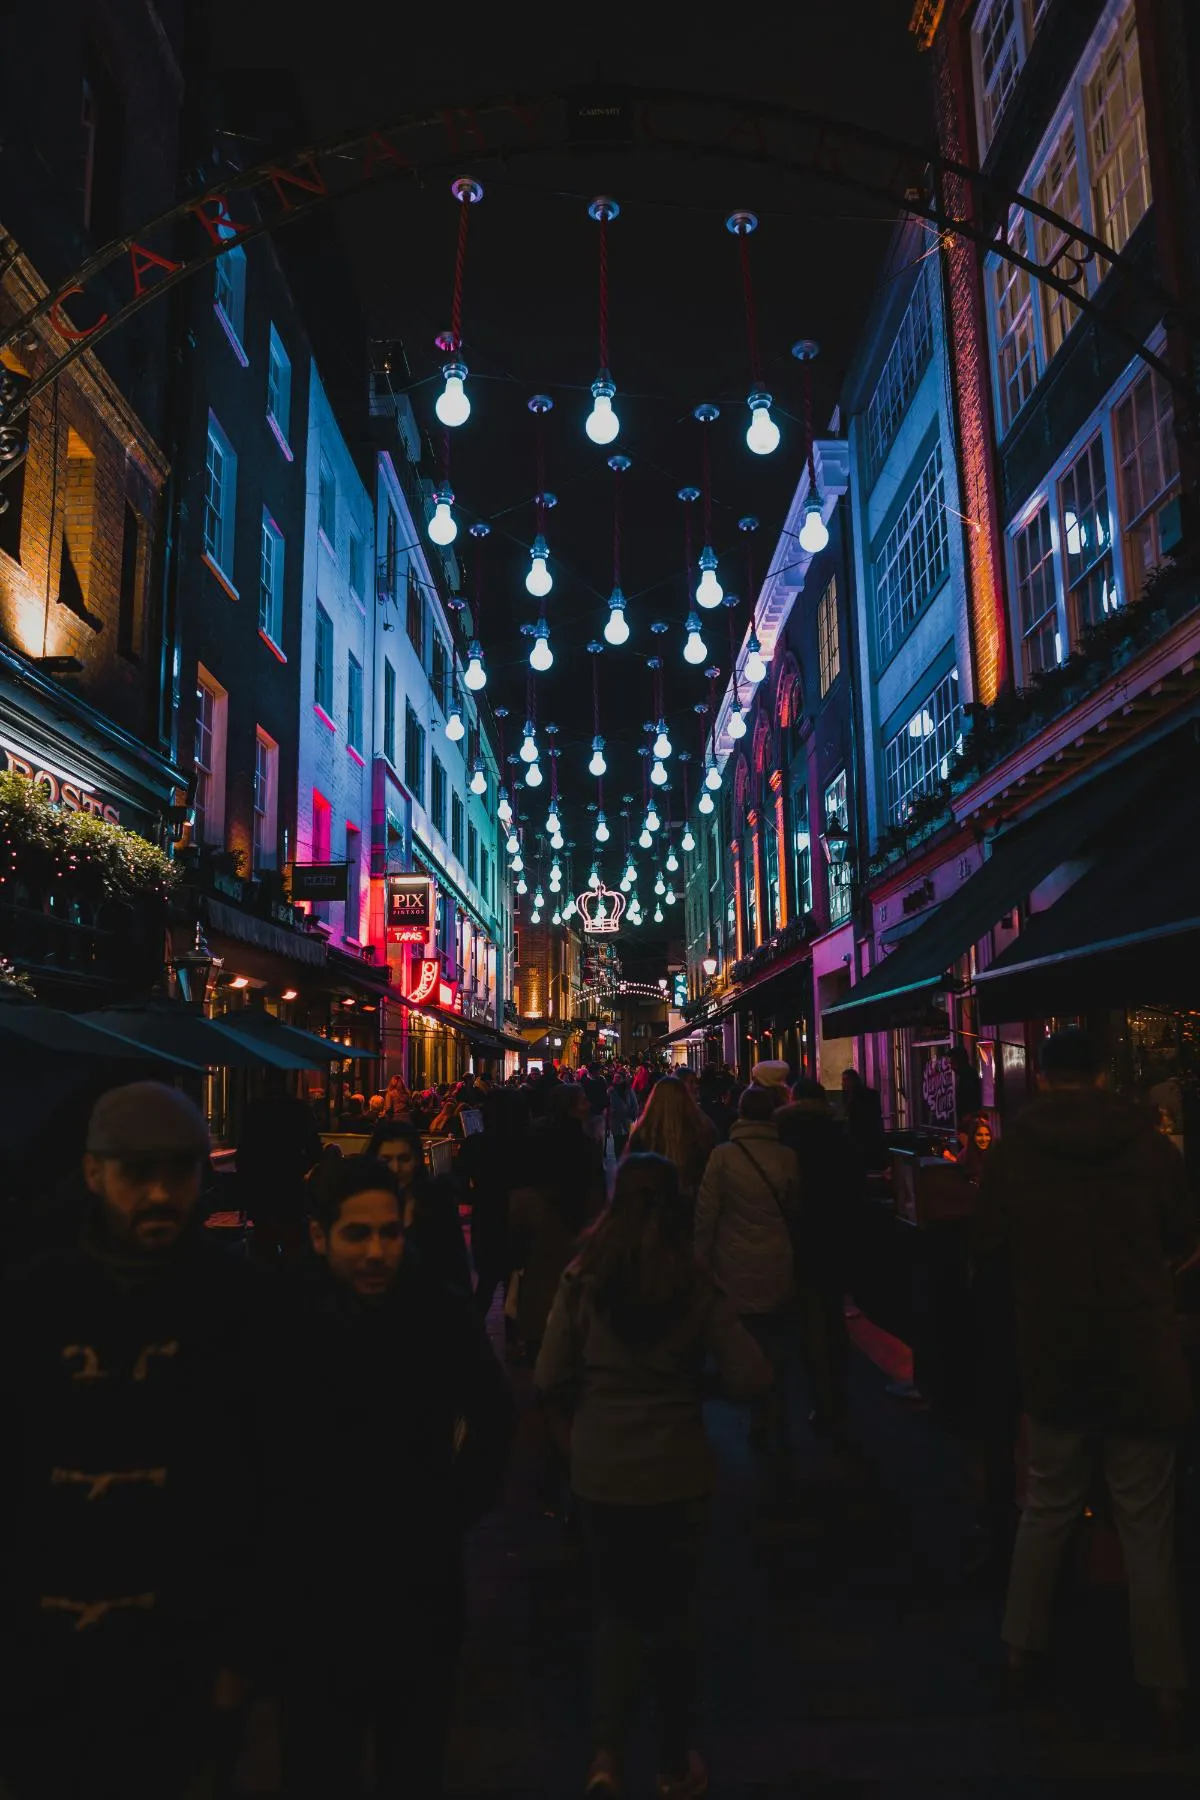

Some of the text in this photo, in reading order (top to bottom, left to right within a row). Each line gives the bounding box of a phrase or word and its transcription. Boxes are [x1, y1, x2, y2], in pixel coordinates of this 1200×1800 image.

[50, 98, 545, 339] CARNABY
[393, 893, 425, 908] PIX
[394, 932, 423, 941] TAPAS
